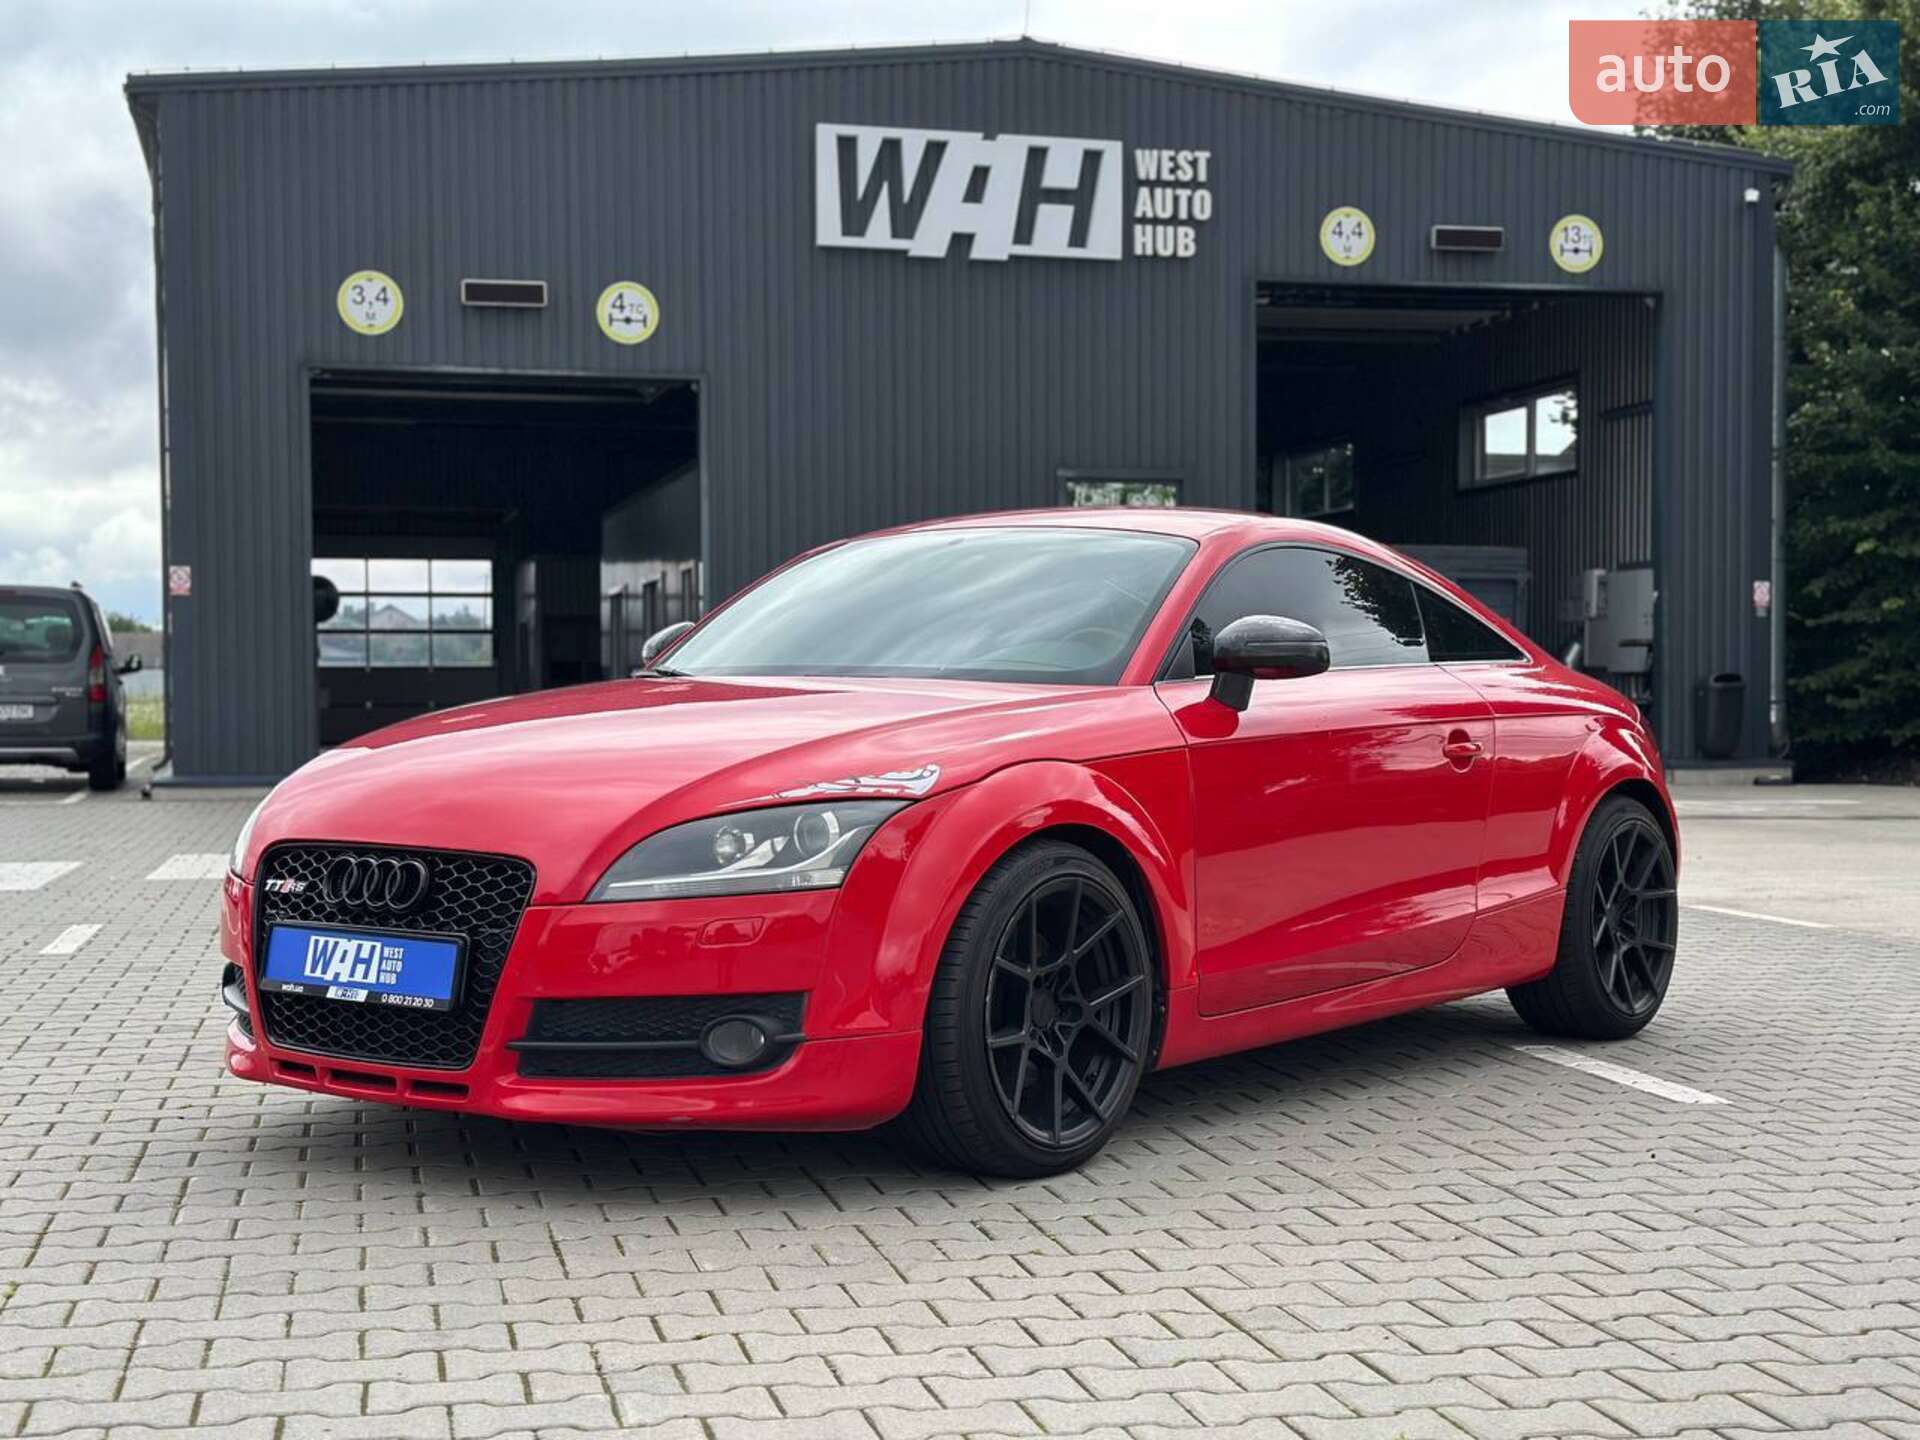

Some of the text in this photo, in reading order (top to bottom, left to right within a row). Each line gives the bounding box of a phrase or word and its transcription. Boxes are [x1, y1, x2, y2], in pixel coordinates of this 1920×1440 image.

[1134, 148, 1212, 183] WEST
[834, 130, 1106, 261] WAH
[1133, 185, 1213, 221] AUTO
[1133, 223, 1198, 258] HUB
[1562, 225, 1582, 244] 13
[351, 284, 390, 309] 3,4
[611, 292, 627, 314] 4
[308, 936, 380, 984] WAH
[383, 945, 404, 959] WEST
[378, 971, 397, 985] HUB
[380, 959, 403, 973] AUTO
